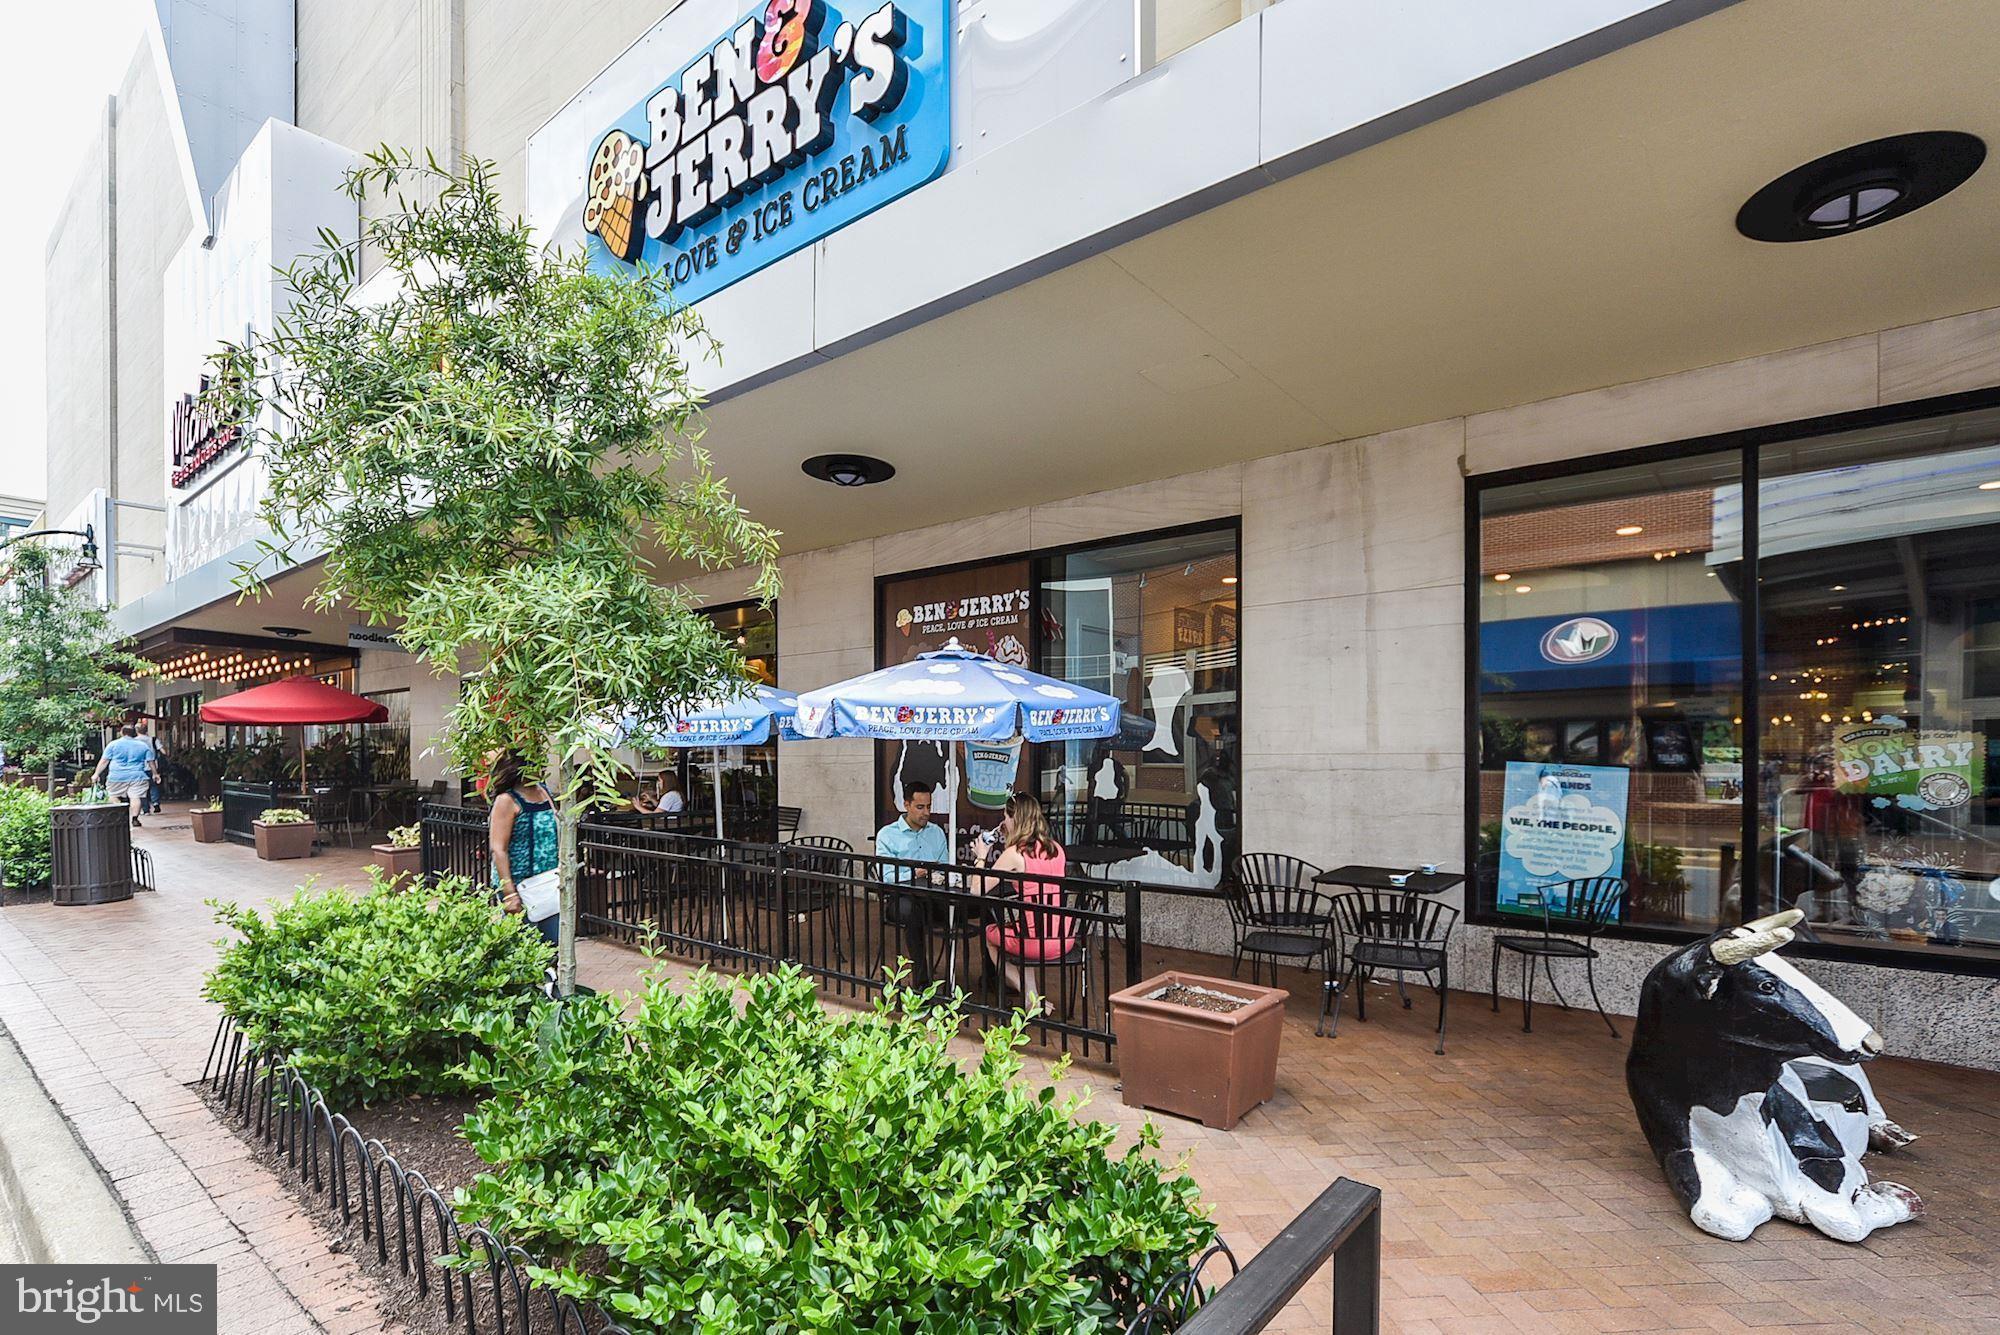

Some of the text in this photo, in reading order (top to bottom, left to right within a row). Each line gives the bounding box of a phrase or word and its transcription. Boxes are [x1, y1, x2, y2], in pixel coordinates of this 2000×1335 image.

[647, 0, 812, 162] BEN &
[645, 1, 894, 240] JERRY'S
[664, 123, 909, 290] LOVE & ICE CREAM
[913, 602, 947, 623] BEN
[958, 589, 1031, 618] JERRY'S
[947, 619, 967, 632] LOVE
[976, 617, 989, 629] ICE
[991, 614, 1019, 626] CREAM
[348, 631, 390, 644] noodles
[690, 717, 754, 734] JERRY'S
[855, 705, 897, 724] BEN
[913, 705, 997, 725] JERRY'S
[1030, 709, 1055, 727] BEN
[1061, 705, 1111, 725] JERRY'S
[899, 726, 922, 735] LOVE
[933, 727, 948, 736] ICE
[950, 726, 980, 735] CREAM
[1839, 741, 1975, 783] DAIRY
[1509, 816, 1534, 828] WE,
[1561, 821, 1617, 836] PEOPLE,
